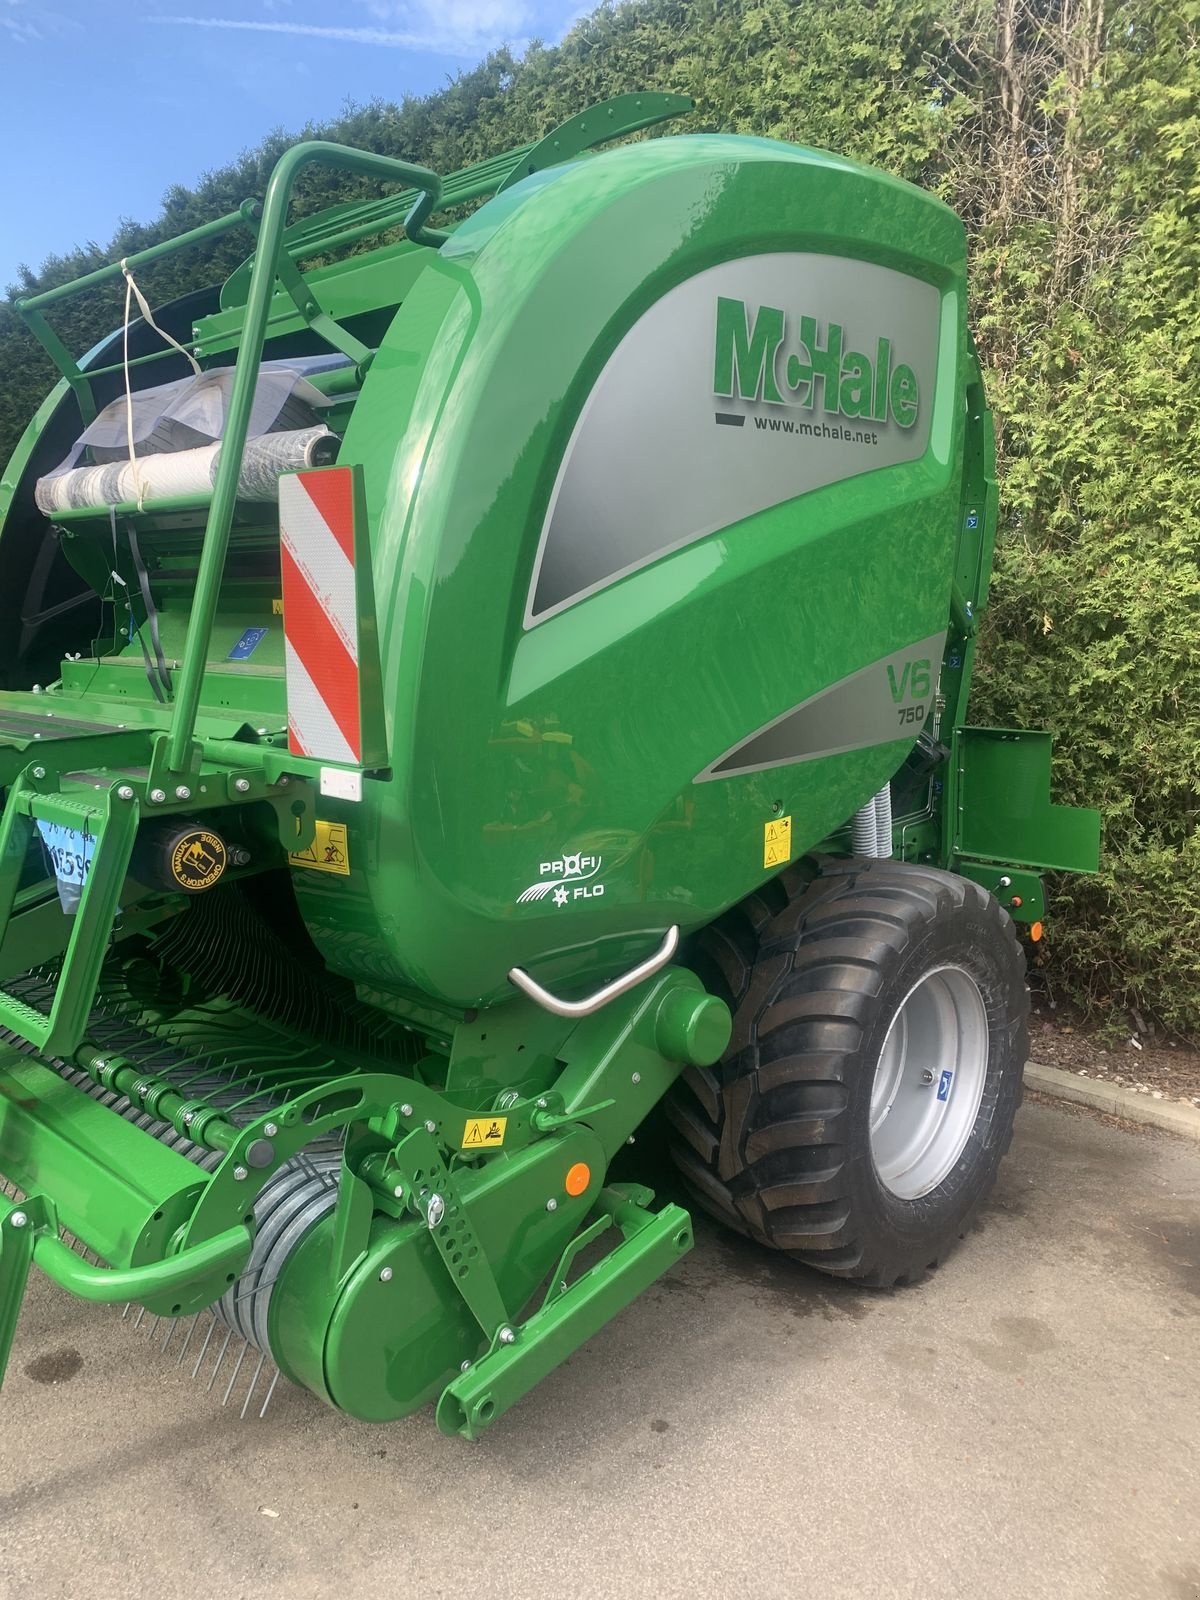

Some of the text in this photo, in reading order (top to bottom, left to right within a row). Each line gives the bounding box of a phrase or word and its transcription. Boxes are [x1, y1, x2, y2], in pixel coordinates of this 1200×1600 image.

[713, 296, 919, 429] McHale
[754, 416, 878, 445] www.mchale.net
[886, 659, 930, 704] V6
[898, 705, 924, 725] 750
[174, 834, 223, 887] OPERATOR'S MANUAL INSIDE
[540, 853, 596, 877] PROFI
[573, 884, 604, 900] FLO
